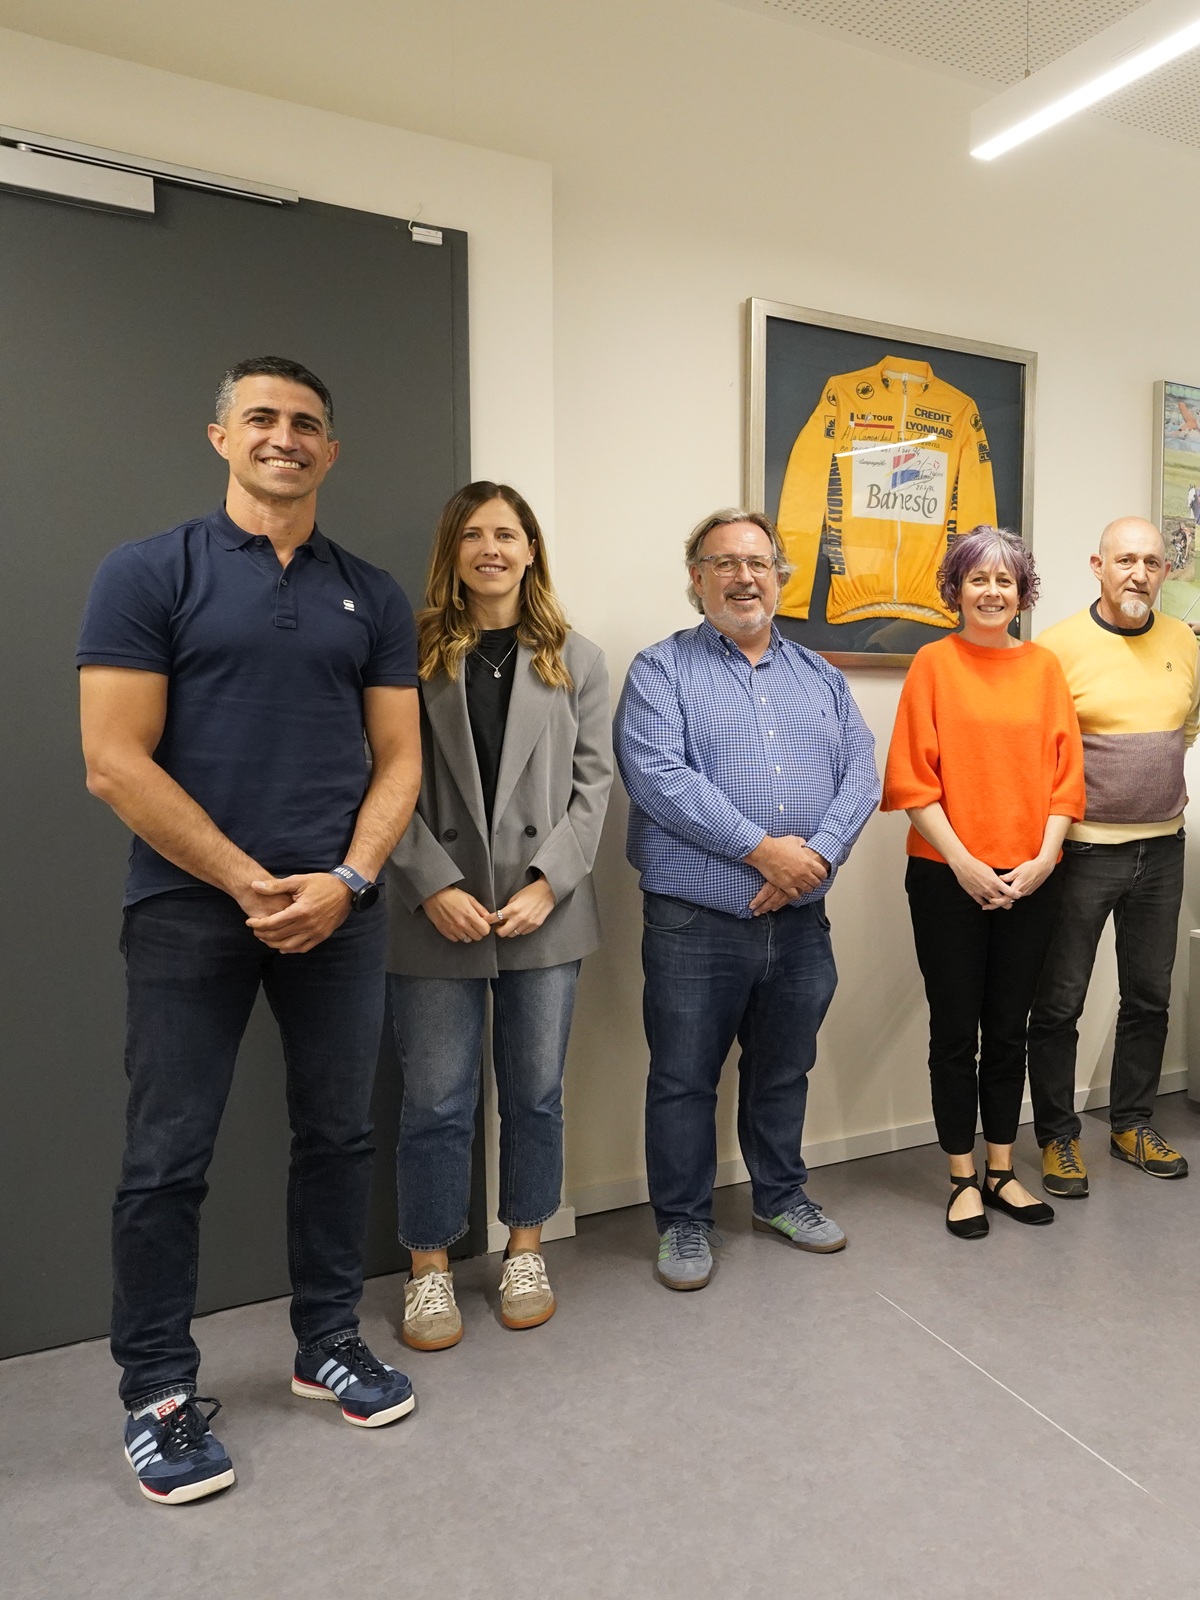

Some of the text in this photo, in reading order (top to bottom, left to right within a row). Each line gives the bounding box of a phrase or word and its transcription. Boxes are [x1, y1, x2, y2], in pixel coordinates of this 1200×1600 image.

[914, 408, 951, 422] CREDIT
[906, 421, 953, 438] LYONNAIS
[866, 484, 938, 518] Banesto
